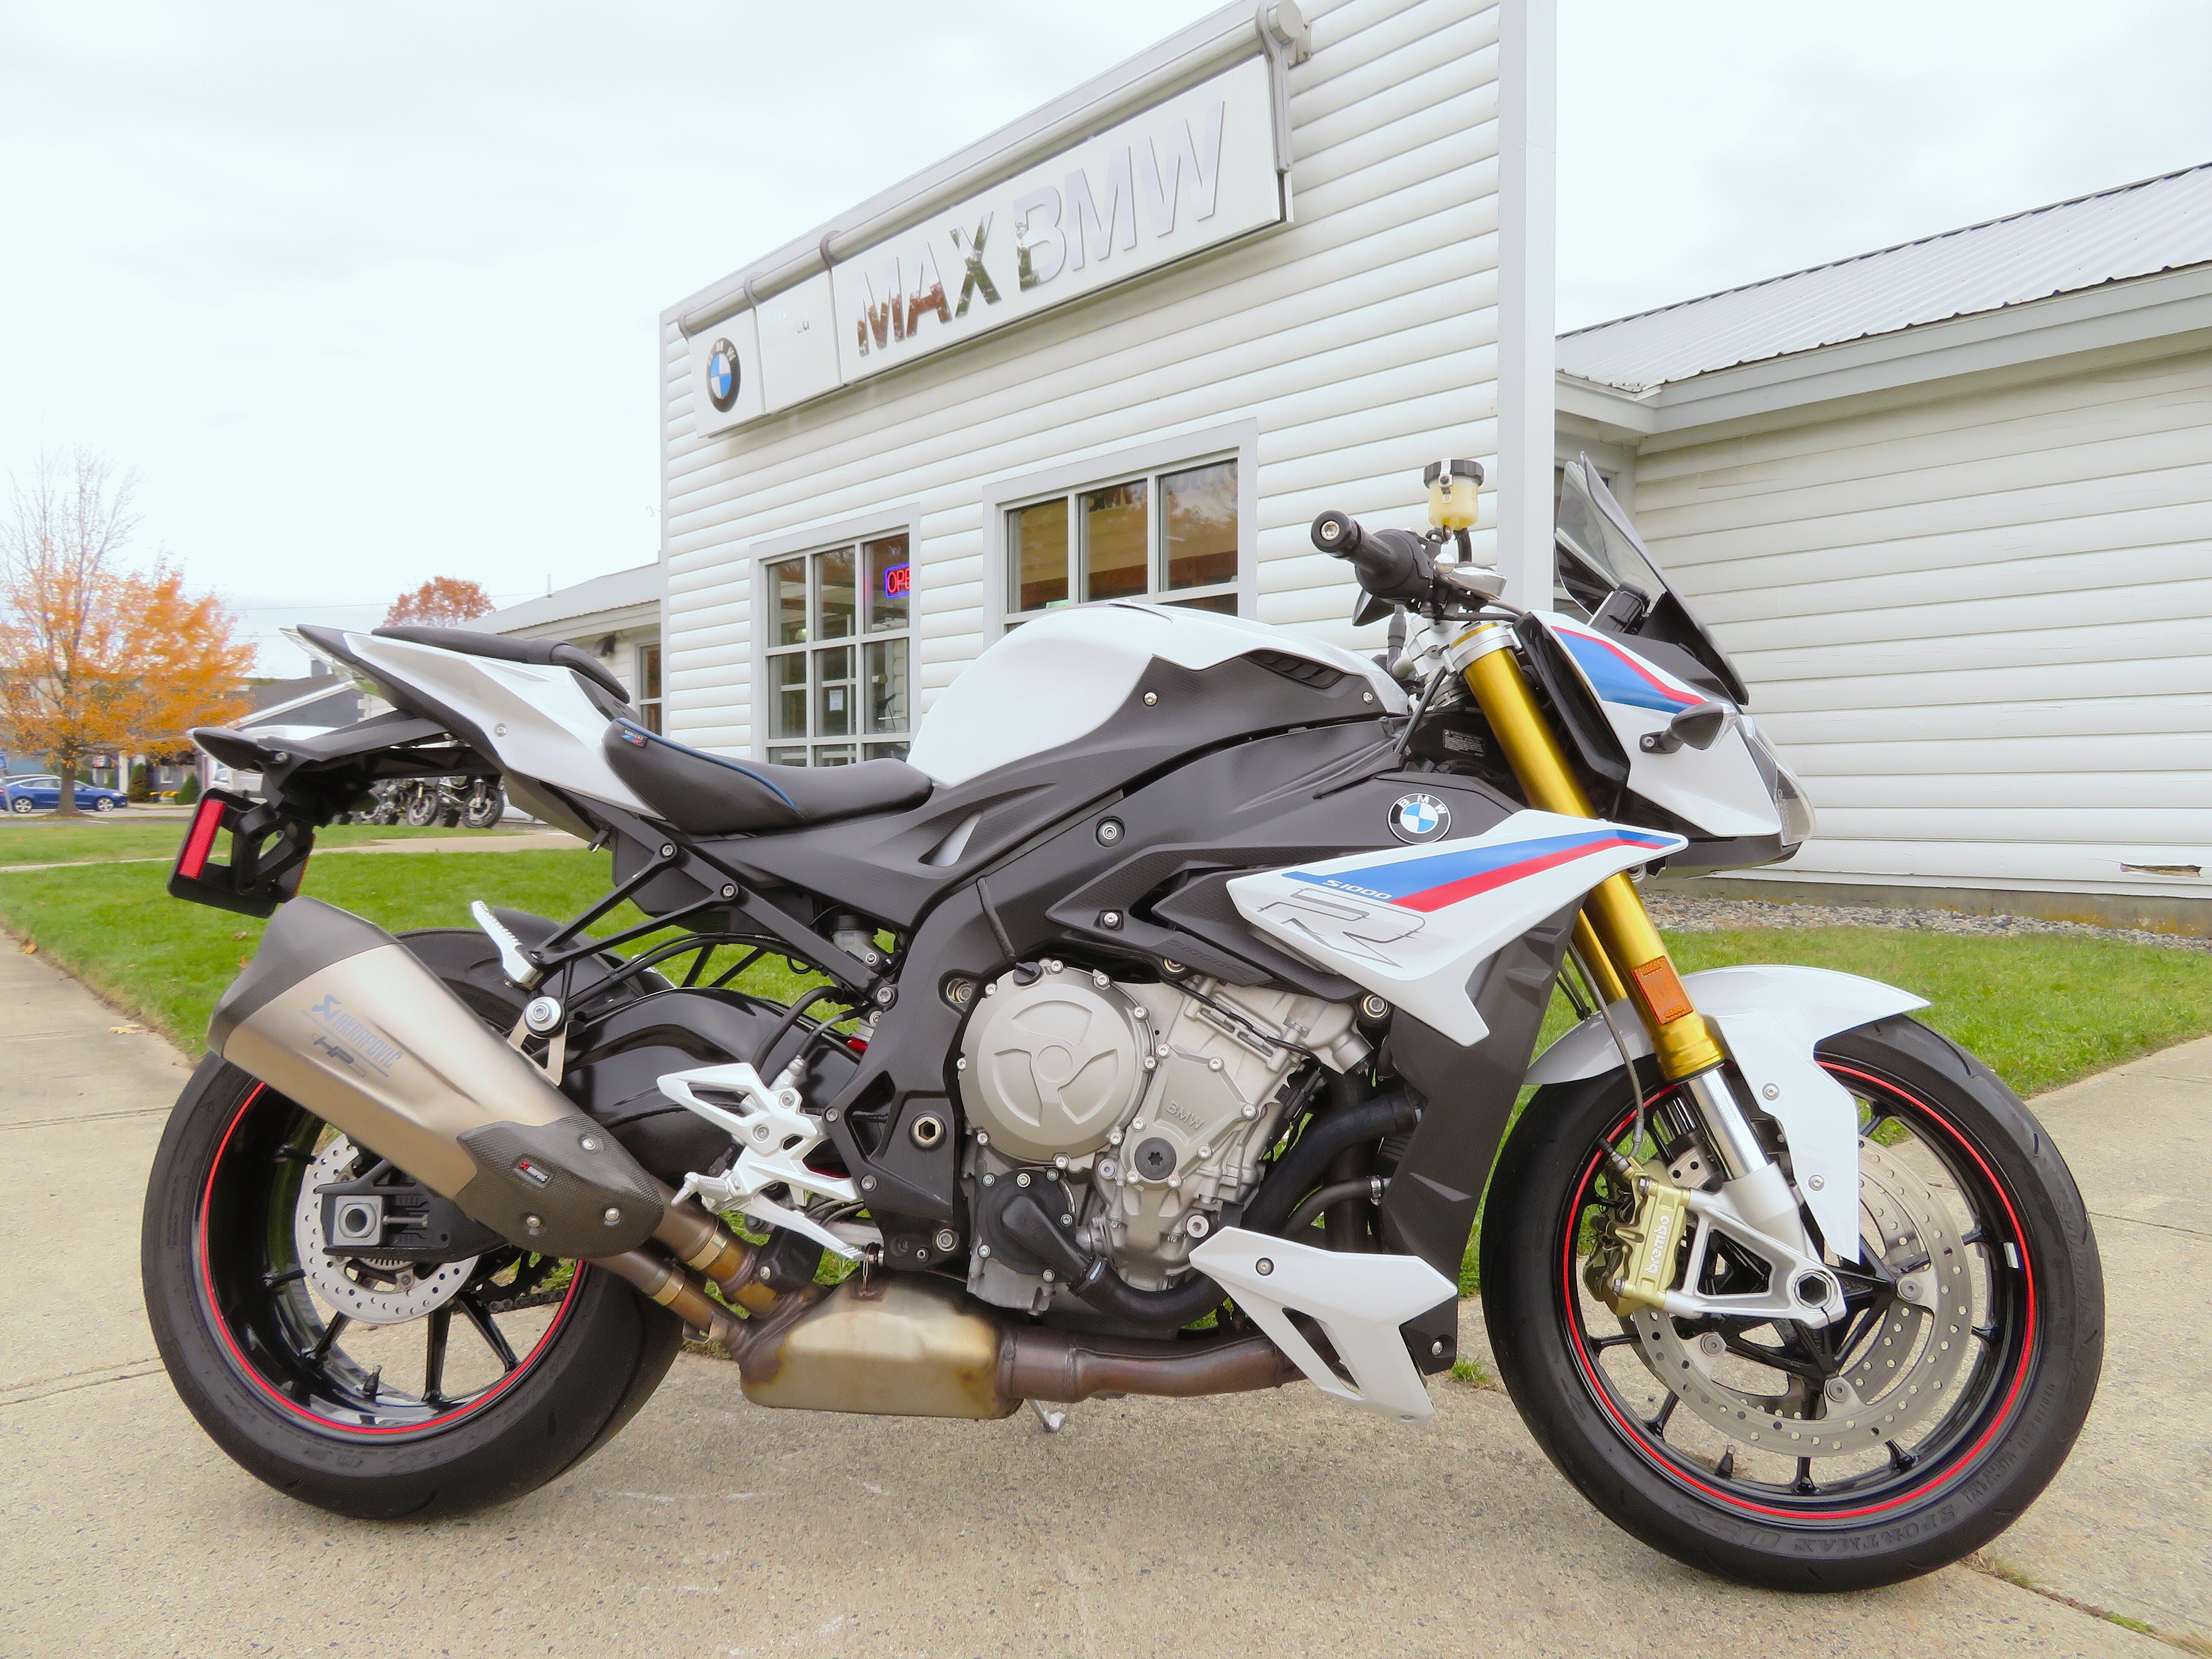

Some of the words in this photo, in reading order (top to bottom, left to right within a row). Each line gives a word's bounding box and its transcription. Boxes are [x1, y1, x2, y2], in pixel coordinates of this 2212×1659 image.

[854, 211, 1002, 357] MAX
[1013, 100, 1225, 291] BMW
[888, 568, 910, 594] OPE
[1397, 795, 1447, 814] BMW
[1321, 879, 1392, 900] S1000
[1166, 1101, 1205, 1130] BMW
[1644, 1216, 1670, 1275] brembo
